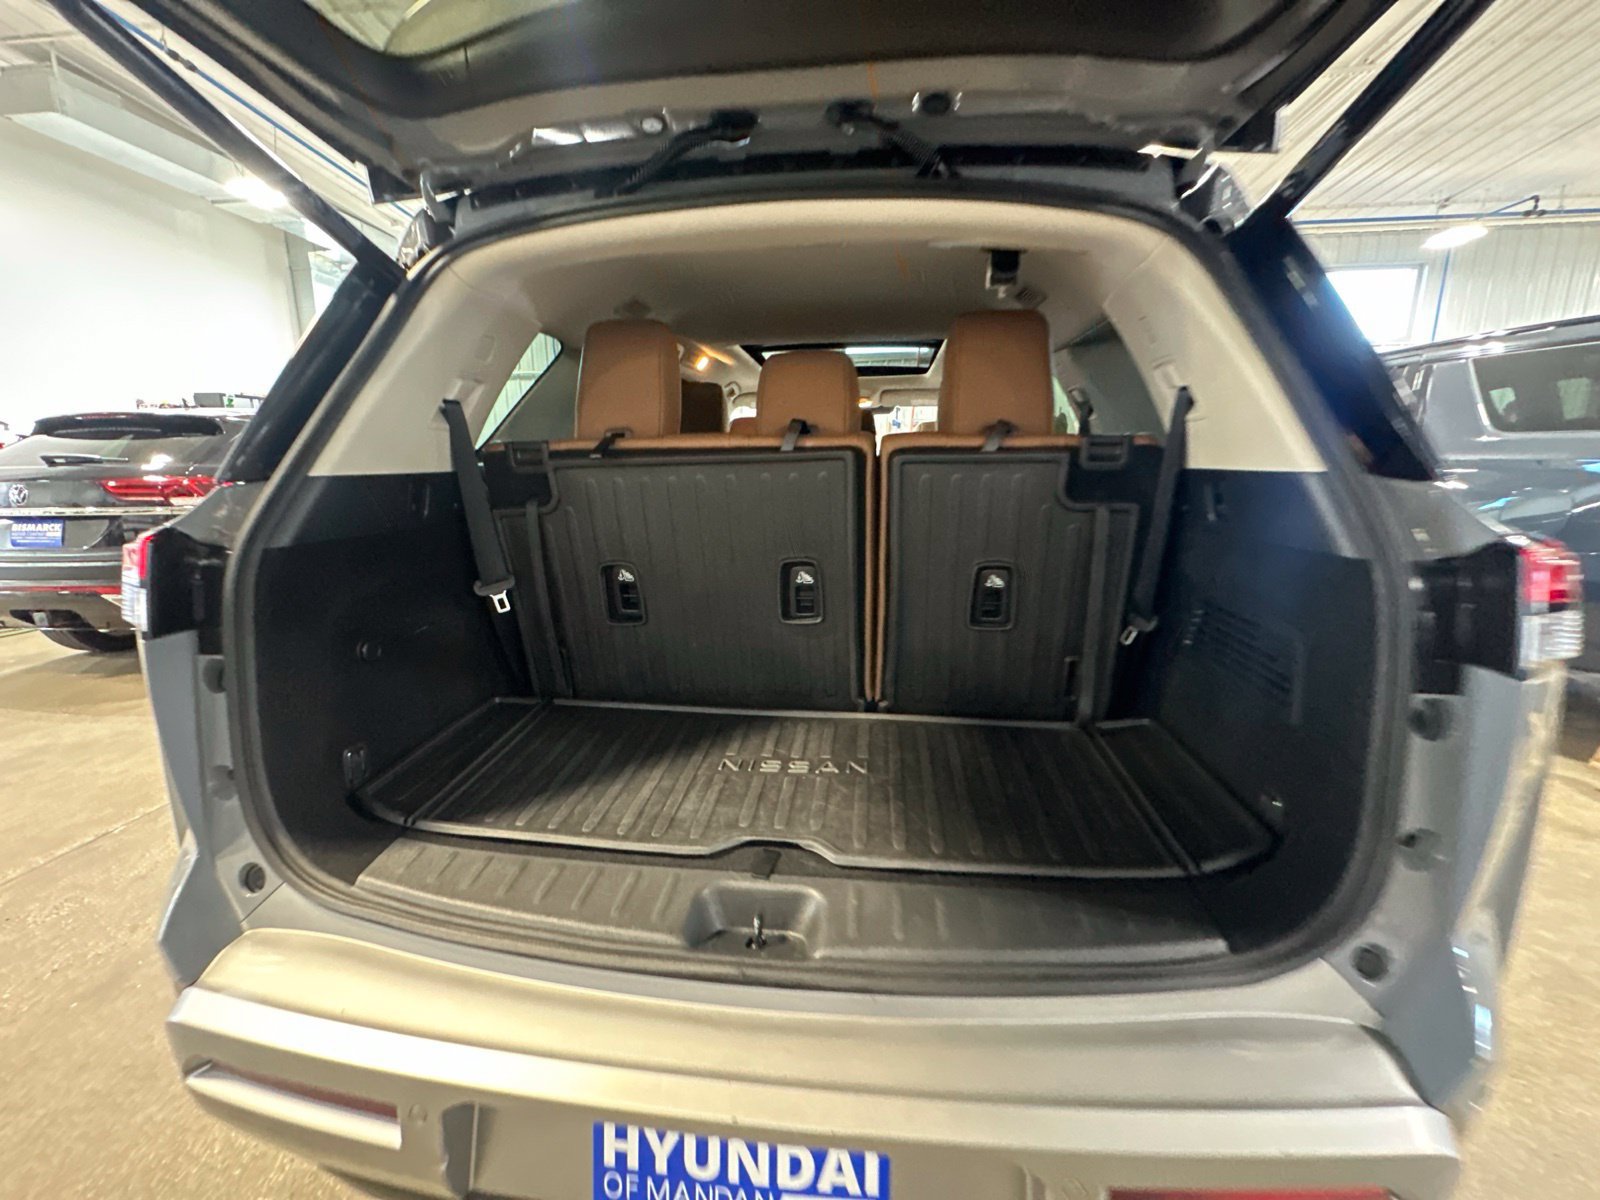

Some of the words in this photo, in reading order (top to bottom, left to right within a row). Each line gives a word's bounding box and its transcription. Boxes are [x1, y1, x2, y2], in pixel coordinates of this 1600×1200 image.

[11, 523, 61, 532] BISMARCK
[718, 758, 868, 774] NISSAN
[603, 1121, 880, 1197] HYUNDAI
[603, 1170, 639, 1200] OF
